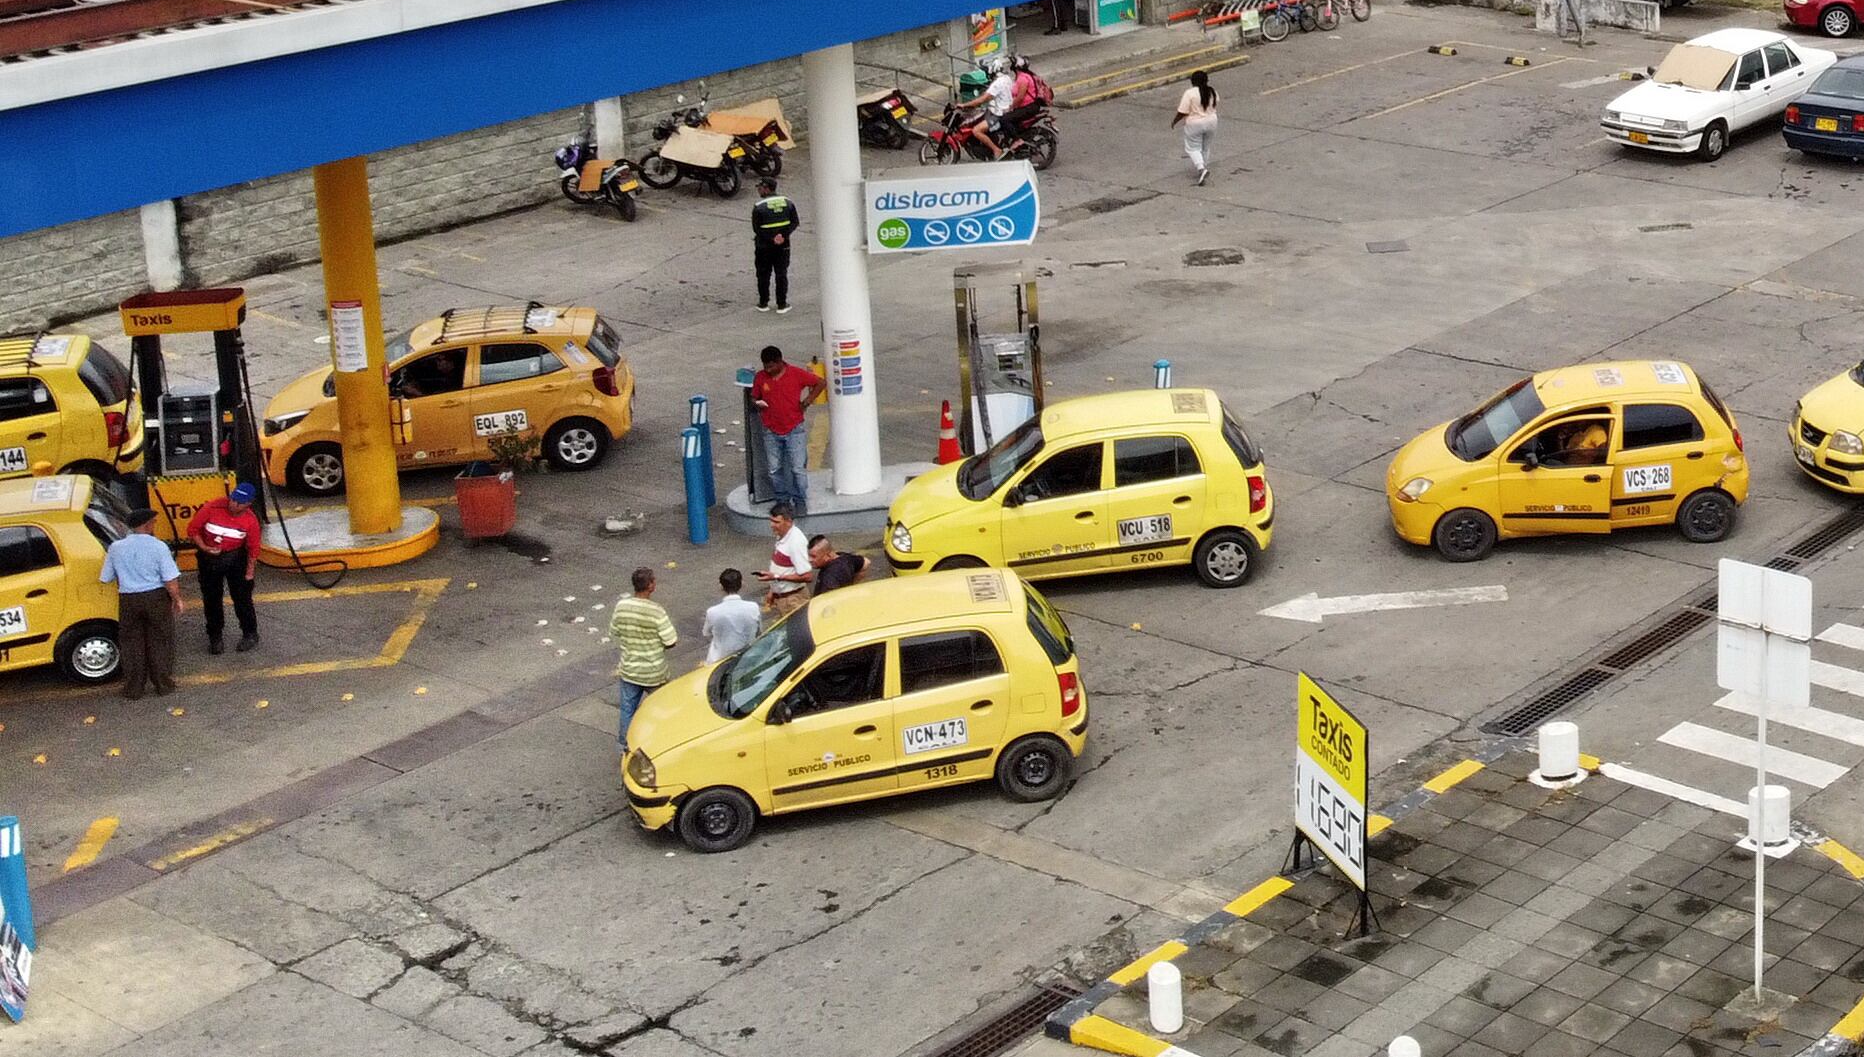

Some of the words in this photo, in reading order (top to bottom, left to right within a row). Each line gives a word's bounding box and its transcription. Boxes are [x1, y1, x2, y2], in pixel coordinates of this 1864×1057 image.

[875, 190, 989, 210] distracom
[880, 226, 906, 240] gas
[130, 314, 172, 327] Taxis
[475, 416, 498, 432] EQL
[505, 412, 526, 427] 892
[0, 450, 24, 467] 144
[1626, 469, 1646, 487] VCS
[1652, 467, 1670, 484] 268
[1119, 520, 1144, 537] VCU
[1150, 518, 1171, 533] 518
[1018, 548, 1051, 560] SERVICIO
[1131, 551, 1164, 564] 6700
[1309, 694, 1353, 763] Taxis
[1310, 734, 1351, 781] CONTADO
[788, 762, 828, 777] SERVICIO
[924, 764, 958, 780] 1318
